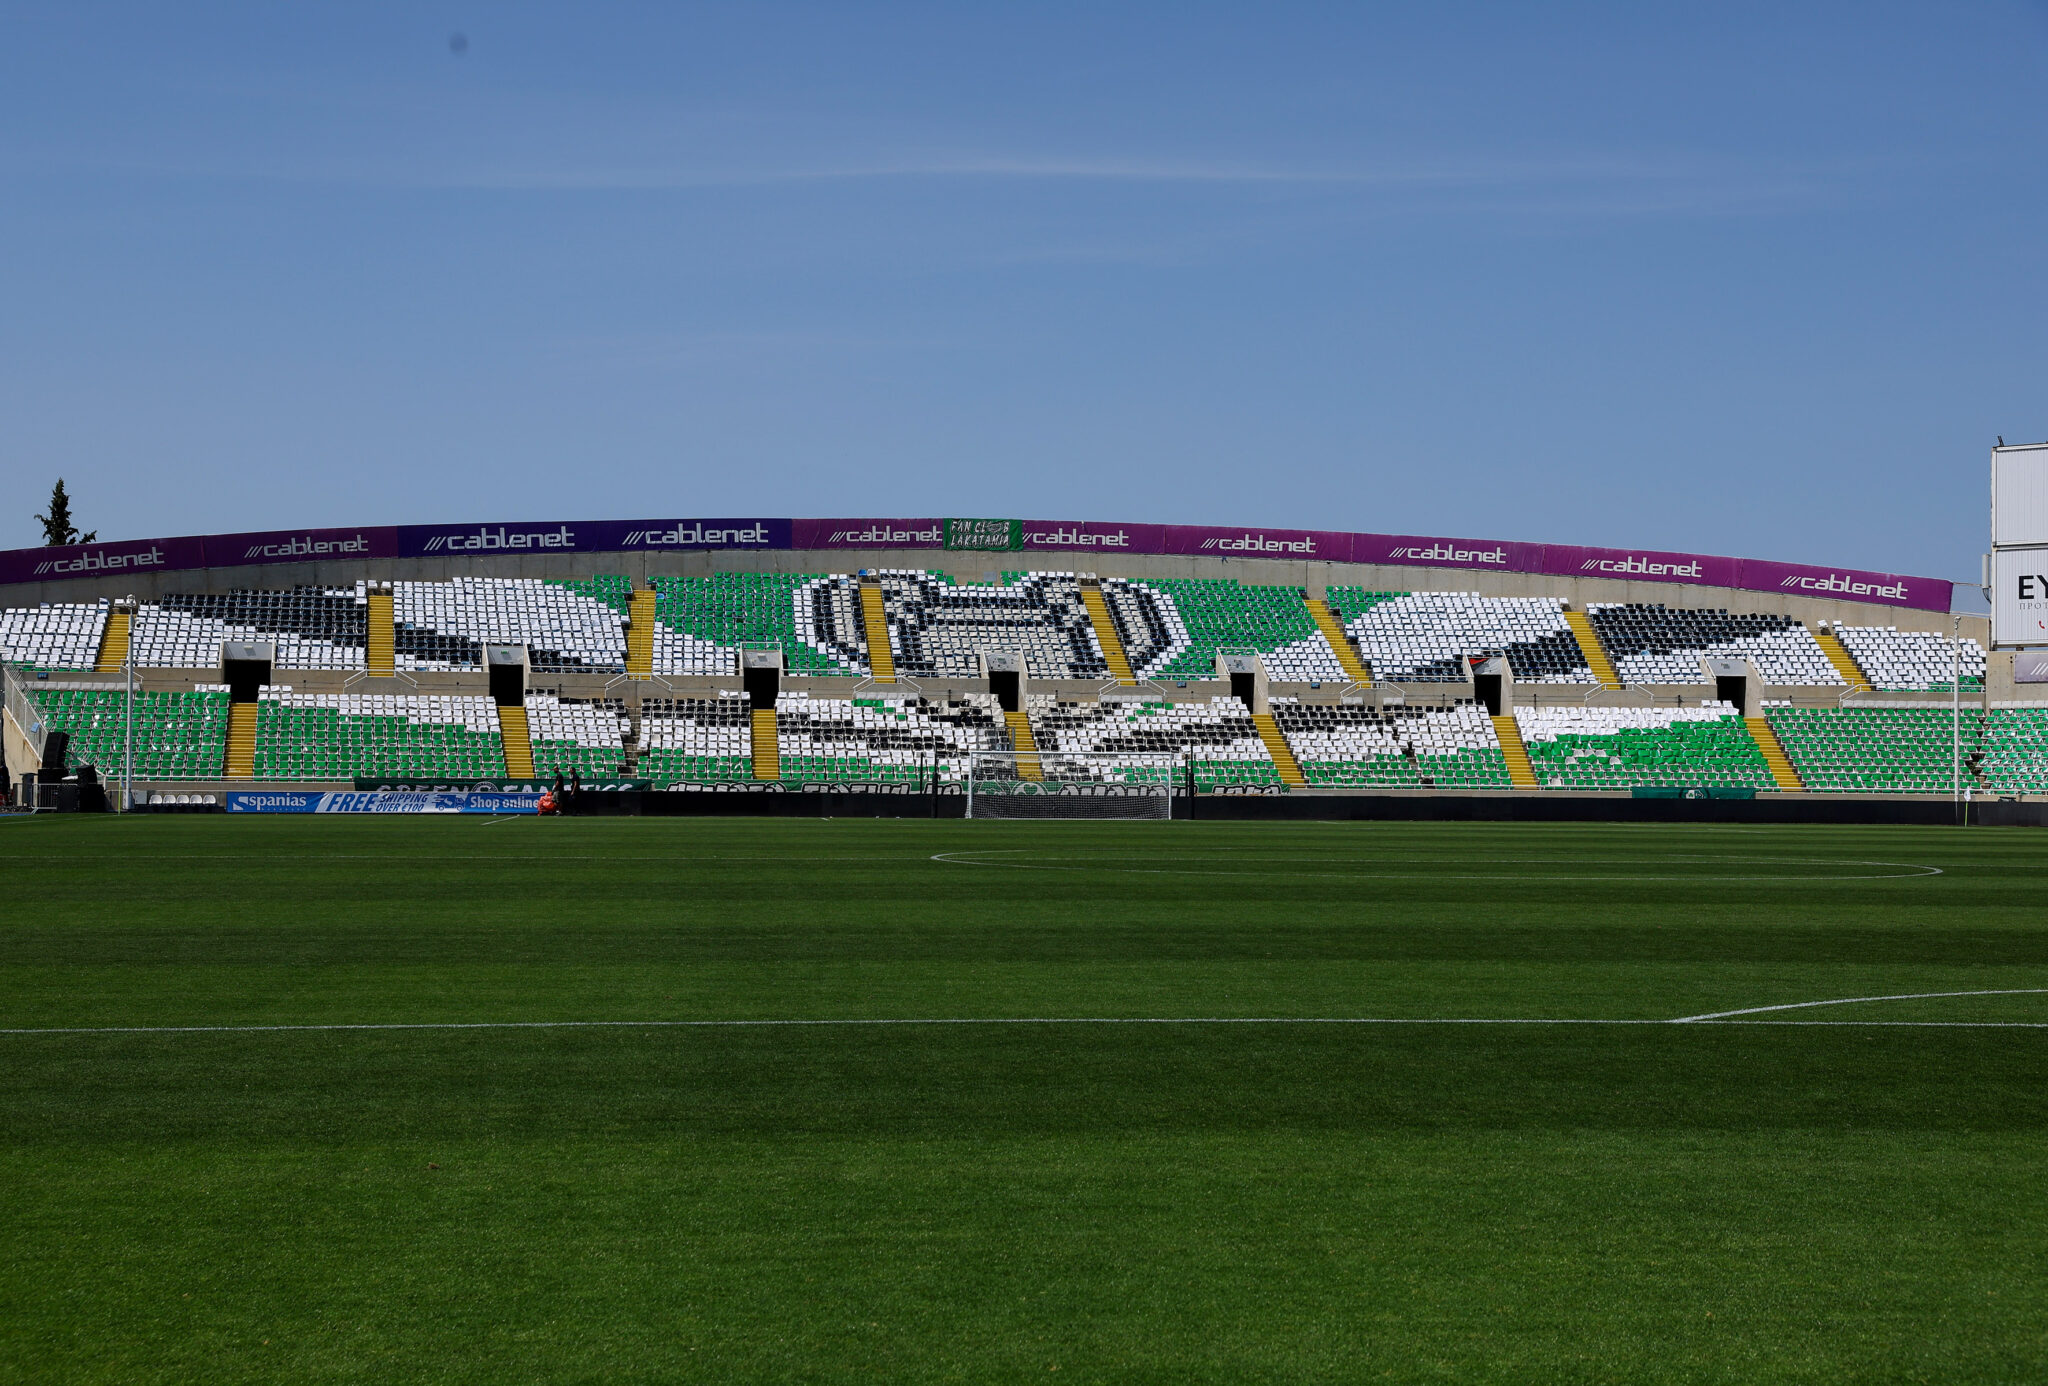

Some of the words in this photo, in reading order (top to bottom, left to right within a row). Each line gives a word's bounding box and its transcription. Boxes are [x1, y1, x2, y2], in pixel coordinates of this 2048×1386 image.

[645, 522, 769, 545] cablenet
[846, 525, 943, 543] cablenet
[950, 520, 972, 534] FAN
[1032, 527, 1129, 547] cablenet
[264, 535, 369, 557] cablenet
[447, 525, 575, 550] cablenet
[950, 534, 1010, 548] LAKATAMIA
[1218, 534, 1316, 554] cablenet
[54, 546, 165, 573] cablenet
[1407, 543, 1507, 564] cablenet
[1600, 556, 1702, 578] cablenet
[1800, 573, 1908, 600] cablenet
[249, 793, 307, 811] spanias
[326, 793, 379, 812] FREE
[375, 803, 399, 812] OVER
[401, 803, 424, 812] €100
[380, 793, 428, 803] SHIPPING
[470, 796, 499, 810] Shop
[502, 796, 539, 809] online
